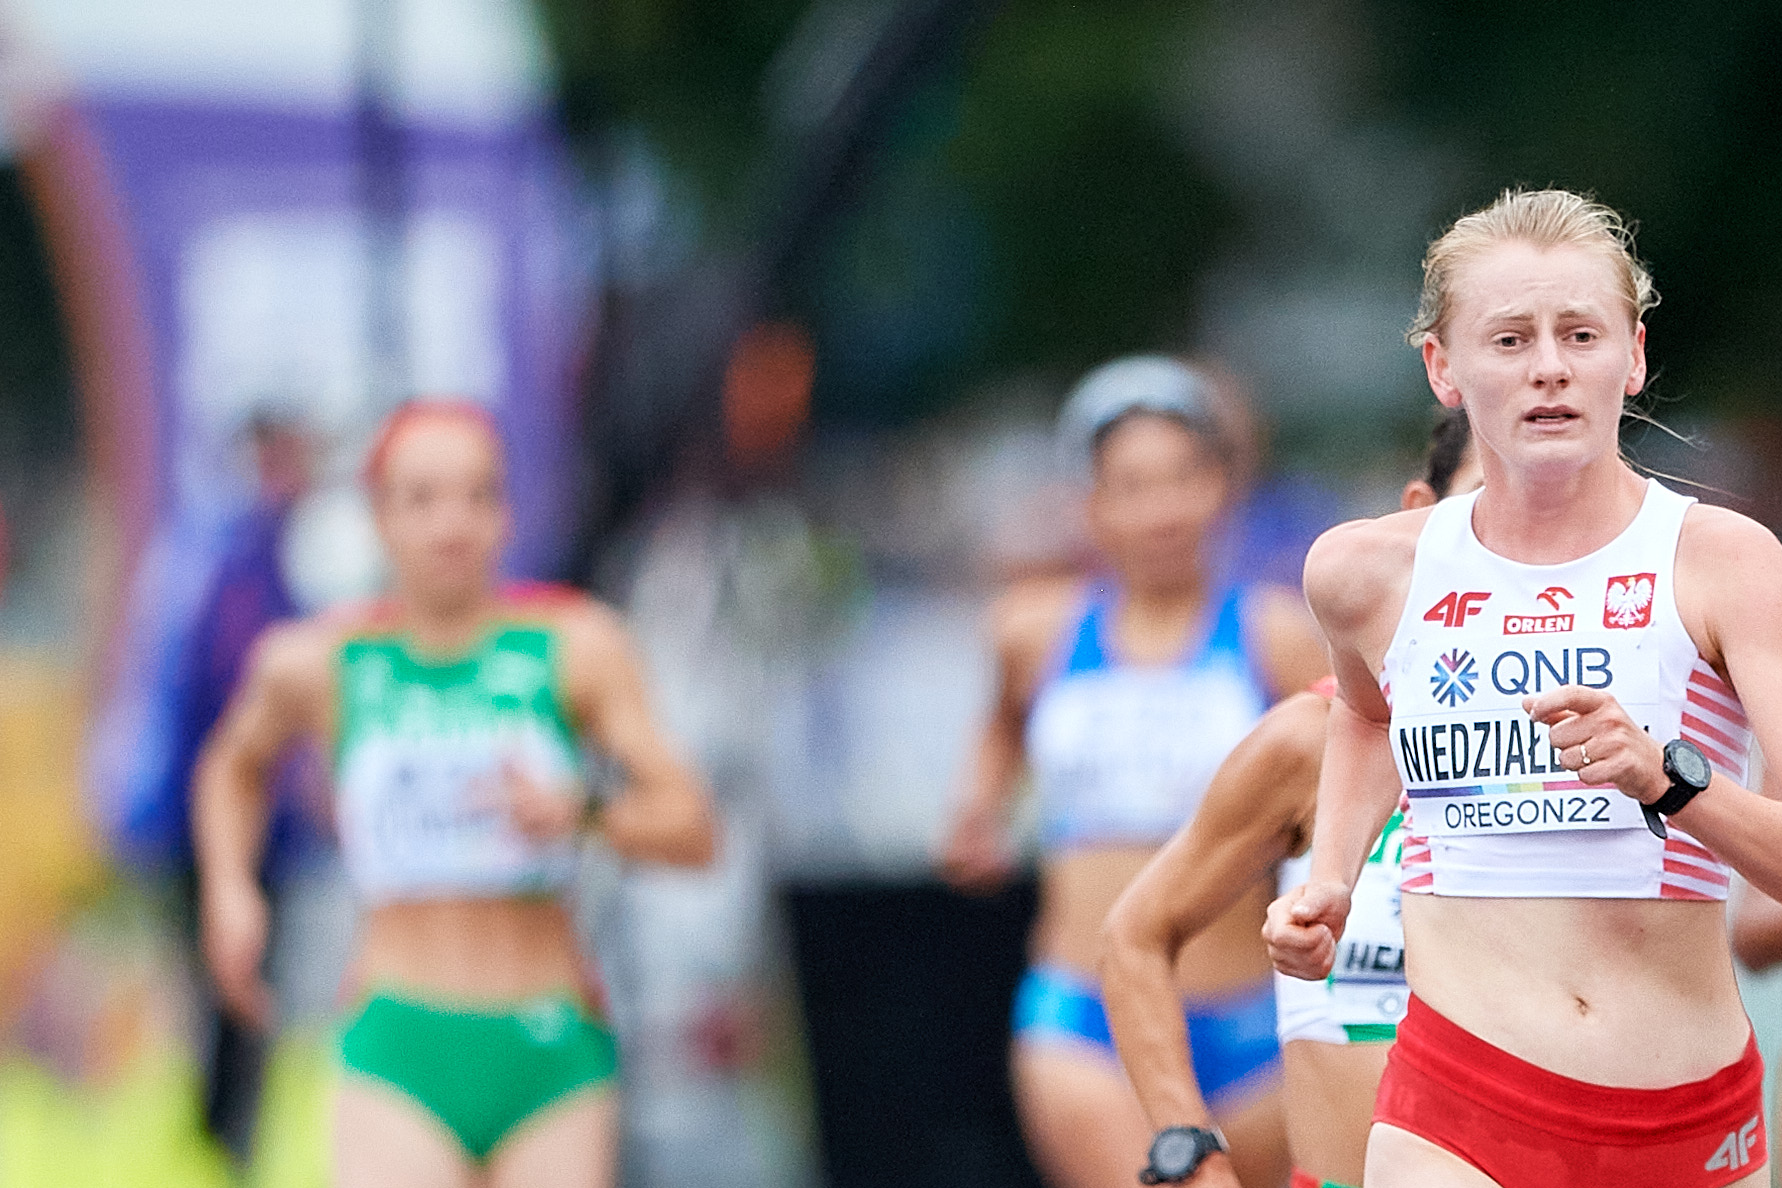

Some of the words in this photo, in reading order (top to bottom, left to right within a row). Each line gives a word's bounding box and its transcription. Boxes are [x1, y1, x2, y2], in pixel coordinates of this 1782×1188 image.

[1506, 616, 1571, 633] ORLEN
[1492, 647, 1613, 695] QNB
[1445, 796, 1611, 829] OREGON22
